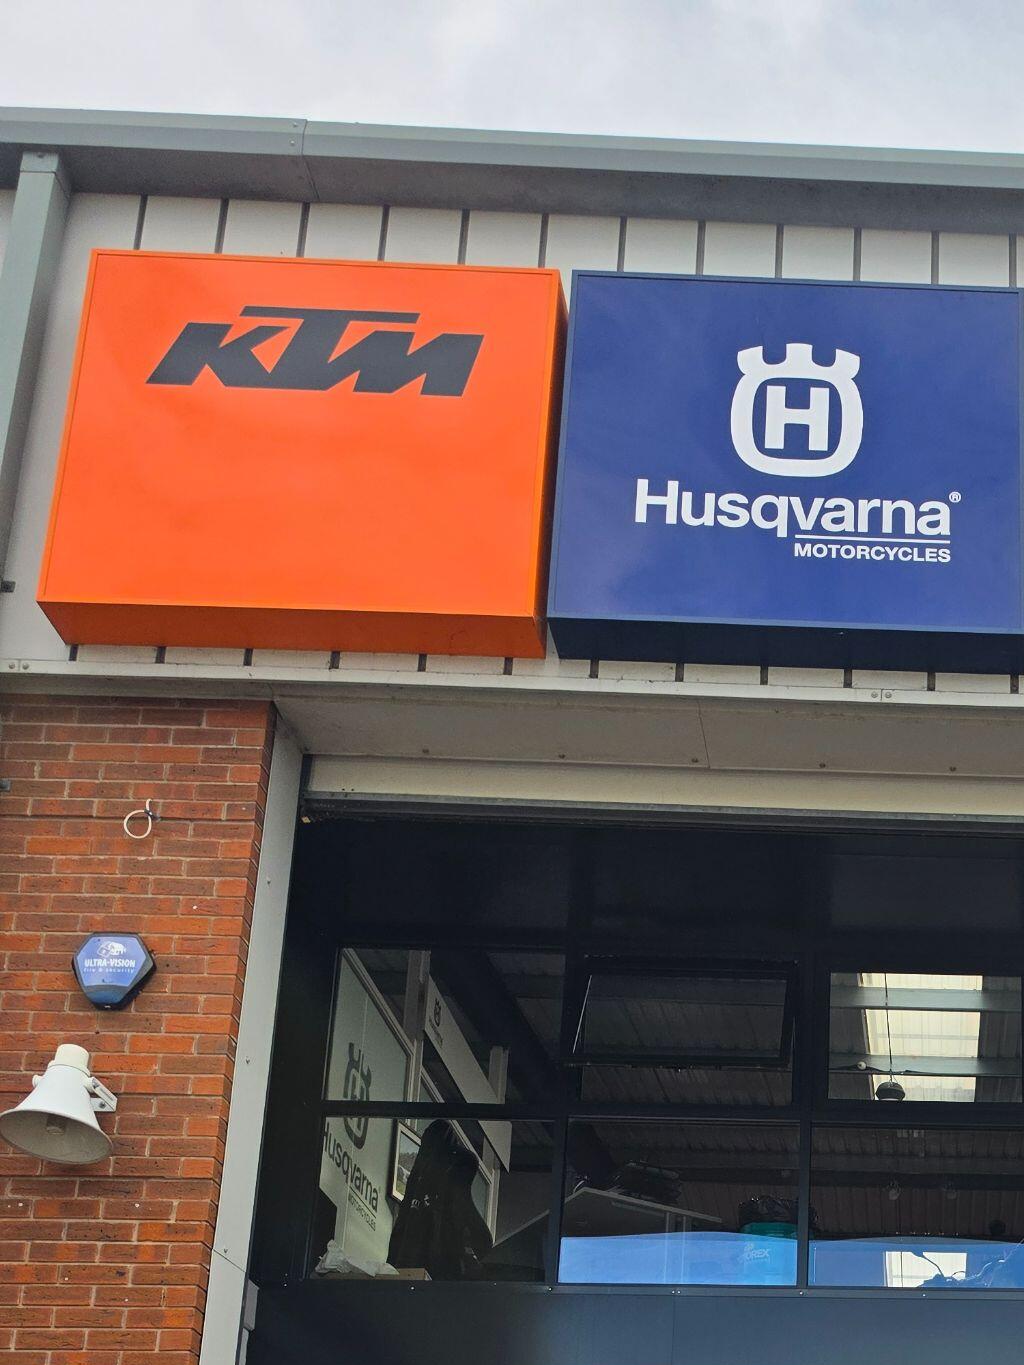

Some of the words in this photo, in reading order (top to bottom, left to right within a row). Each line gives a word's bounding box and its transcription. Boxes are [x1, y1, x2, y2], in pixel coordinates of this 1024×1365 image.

[146, 306, 484, 397] KTM
[794, 543, 952, 563] MOTORCYCLES
[84, 959, 135, 968] ULTRA-VISION
